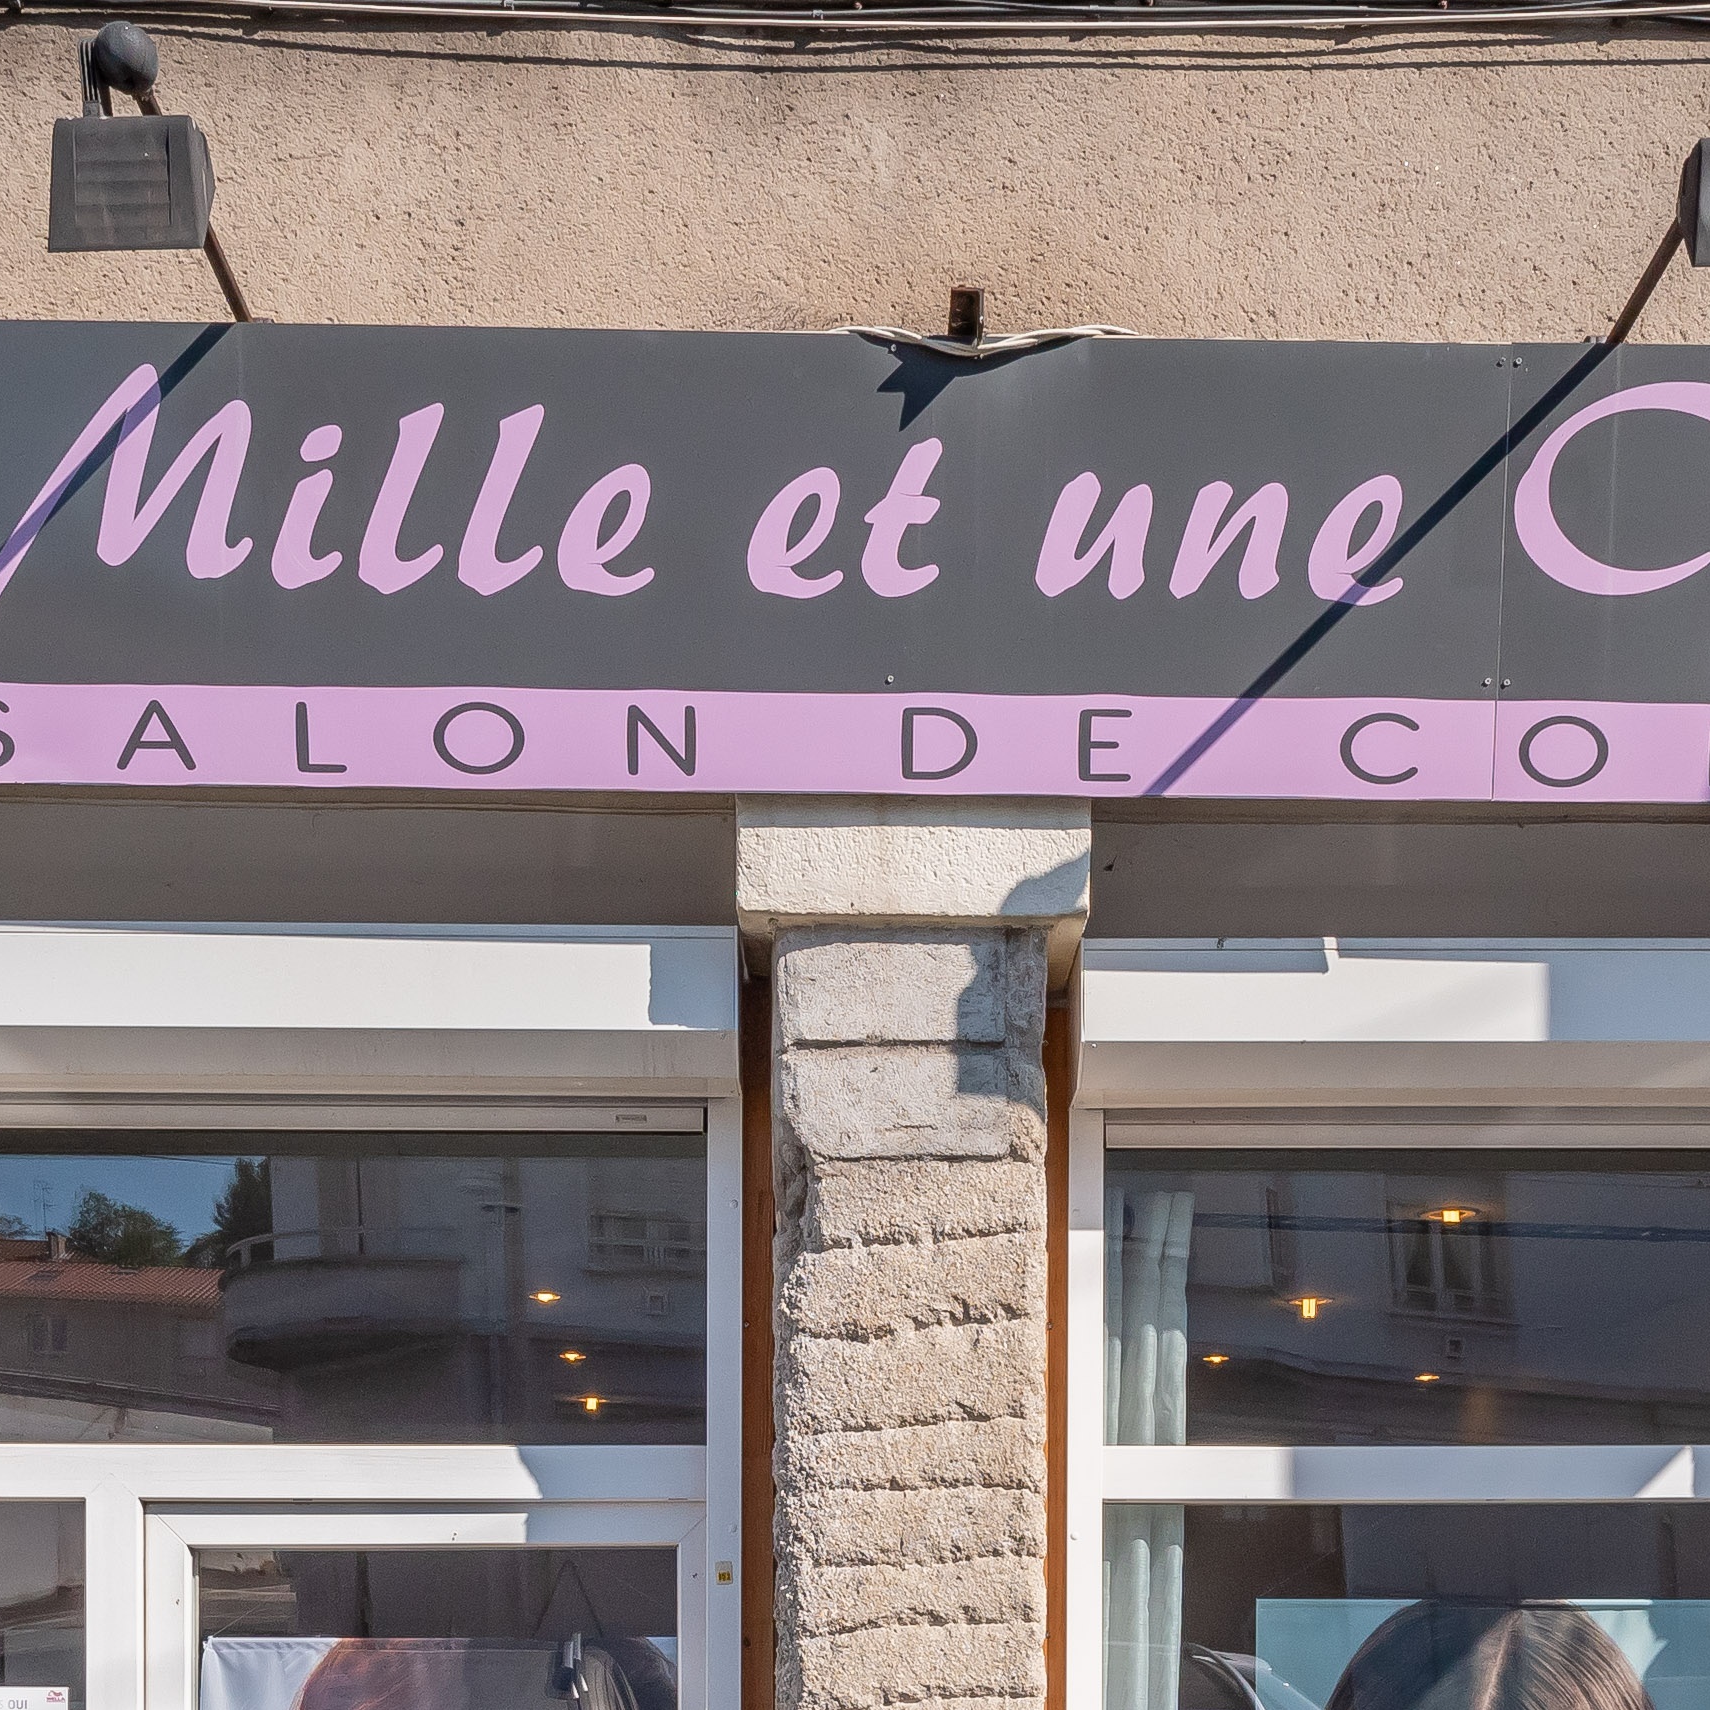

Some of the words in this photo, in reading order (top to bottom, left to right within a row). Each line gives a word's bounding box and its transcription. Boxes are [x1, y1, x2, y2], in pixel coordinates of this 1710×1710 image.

[746, 438, 943, 598] et
[1033, 470, 1405, 608] une
[900, 704, 1133, 783] DE
[8, 1700, 27, 1709] OUI
